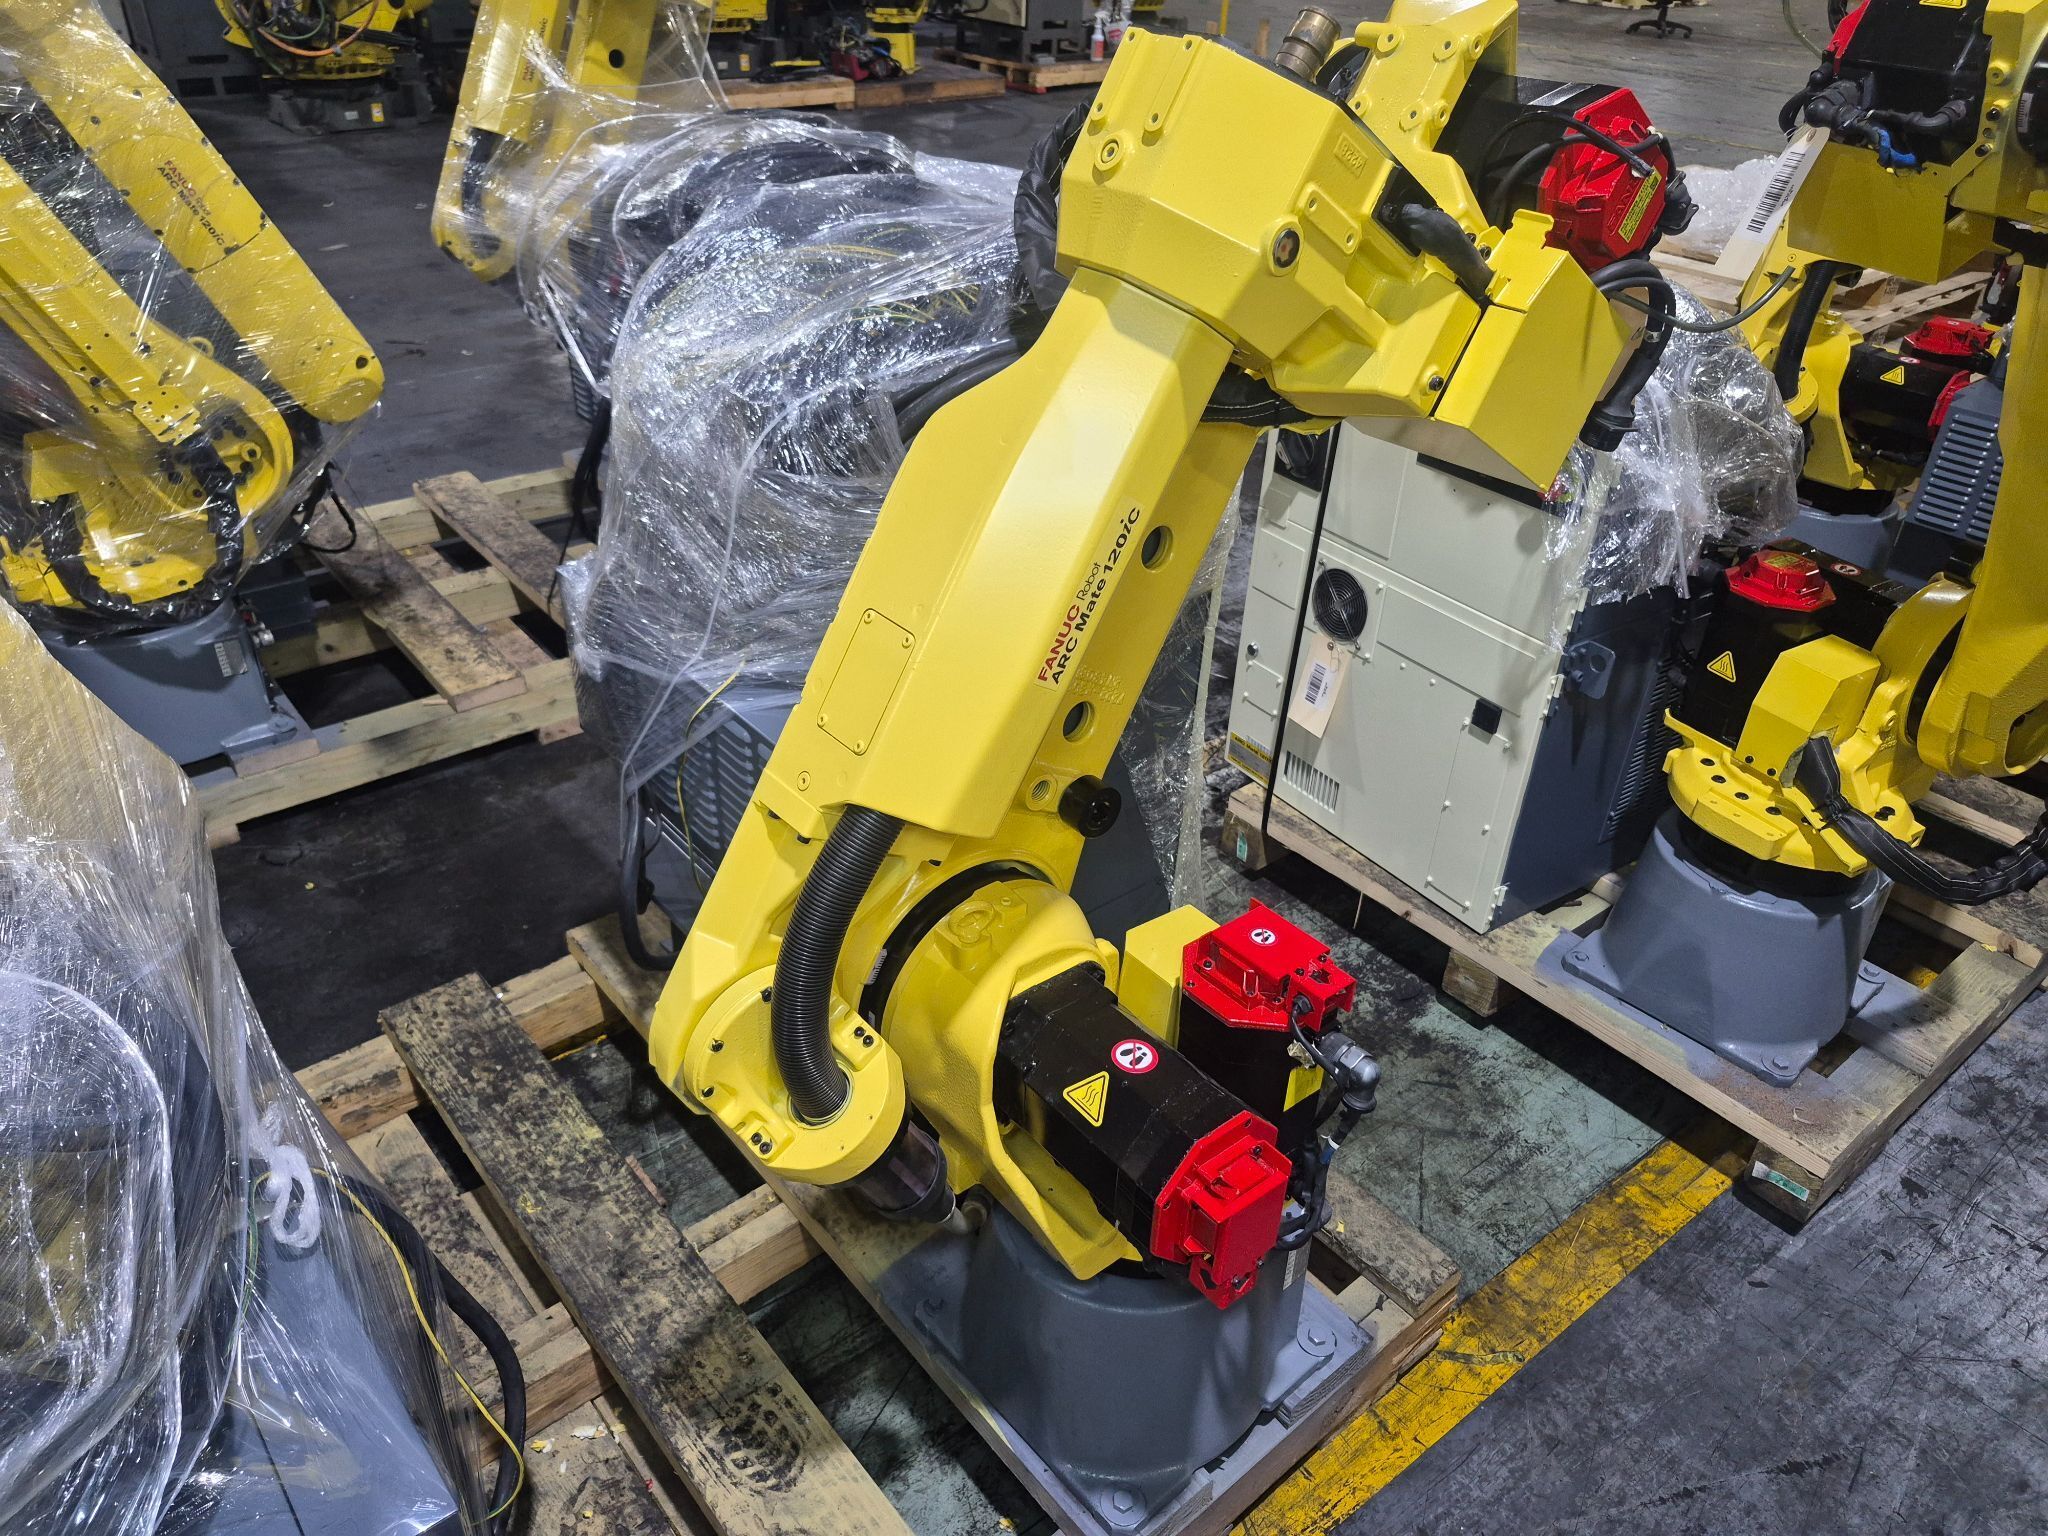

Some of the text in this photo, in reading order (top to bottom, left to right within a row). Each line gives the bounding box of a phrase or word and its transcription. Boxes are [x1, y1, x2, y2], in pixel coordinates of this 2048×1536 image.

[157, 167, 179, 190] ARC
[199, 215, 225, 246] 120iC
[163, 160, 197, 197] FANUC
[1037, 562, 1102, 682] FANUC Robot
[1051, 636, 1078, 686] ARC
[1074, 579, 1107, 632] Mate
[1103, 507, 1142, 573] 120iC
